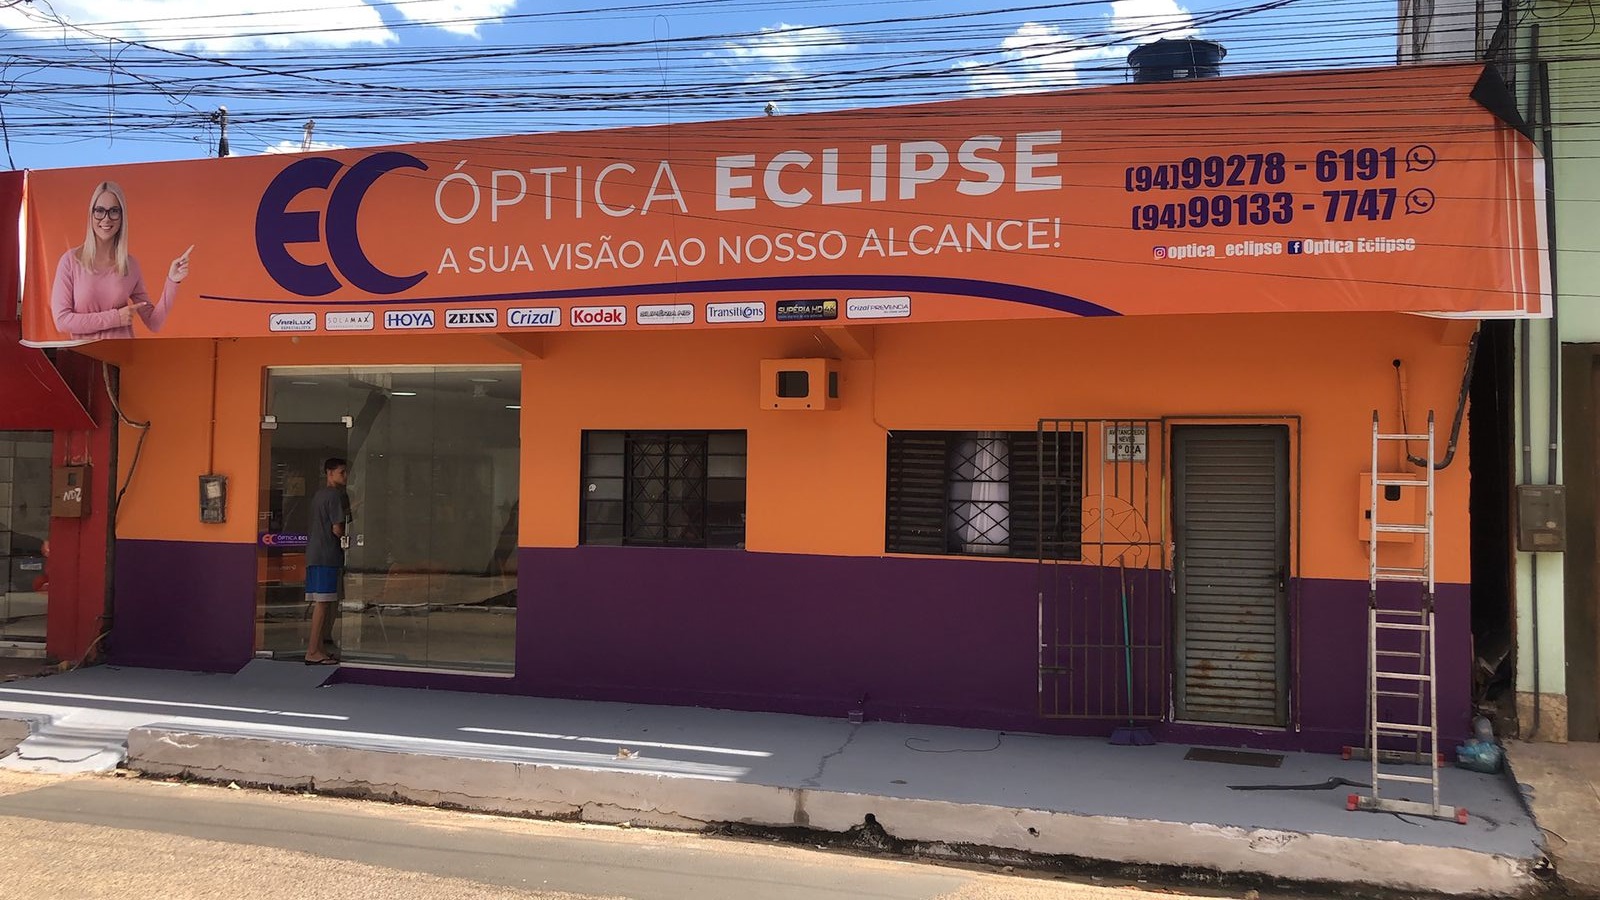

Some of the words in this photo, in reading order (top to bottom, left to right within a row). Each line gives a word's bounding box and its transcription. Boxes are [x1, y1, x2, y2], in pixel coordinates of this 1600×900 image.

[1315, 147, 1397, 182] 6191
[434, 160, 689, 225] ÓPTICA
[715, 130, 1063, 212] ECLIPSE
[1322, 188, 1398, 222] 7747
[437, 247, 461, 275] A
[467, 244, 534, 273] SUA
[541, 235, 645, 271] VISÃO
[654, 238, 707, 268] AO
[718, 230, 848, 265] NOSSO
[858, 217, 1063, 259] ALCANCE!
[448, 312, 495, 324] ZEISS
[510, 310, 554, 325] Crizal
[574, 309, 622, 323] Kodak
[708, 306, 764, 318] Transitions
[387, 313, 433, 327] HOYA
